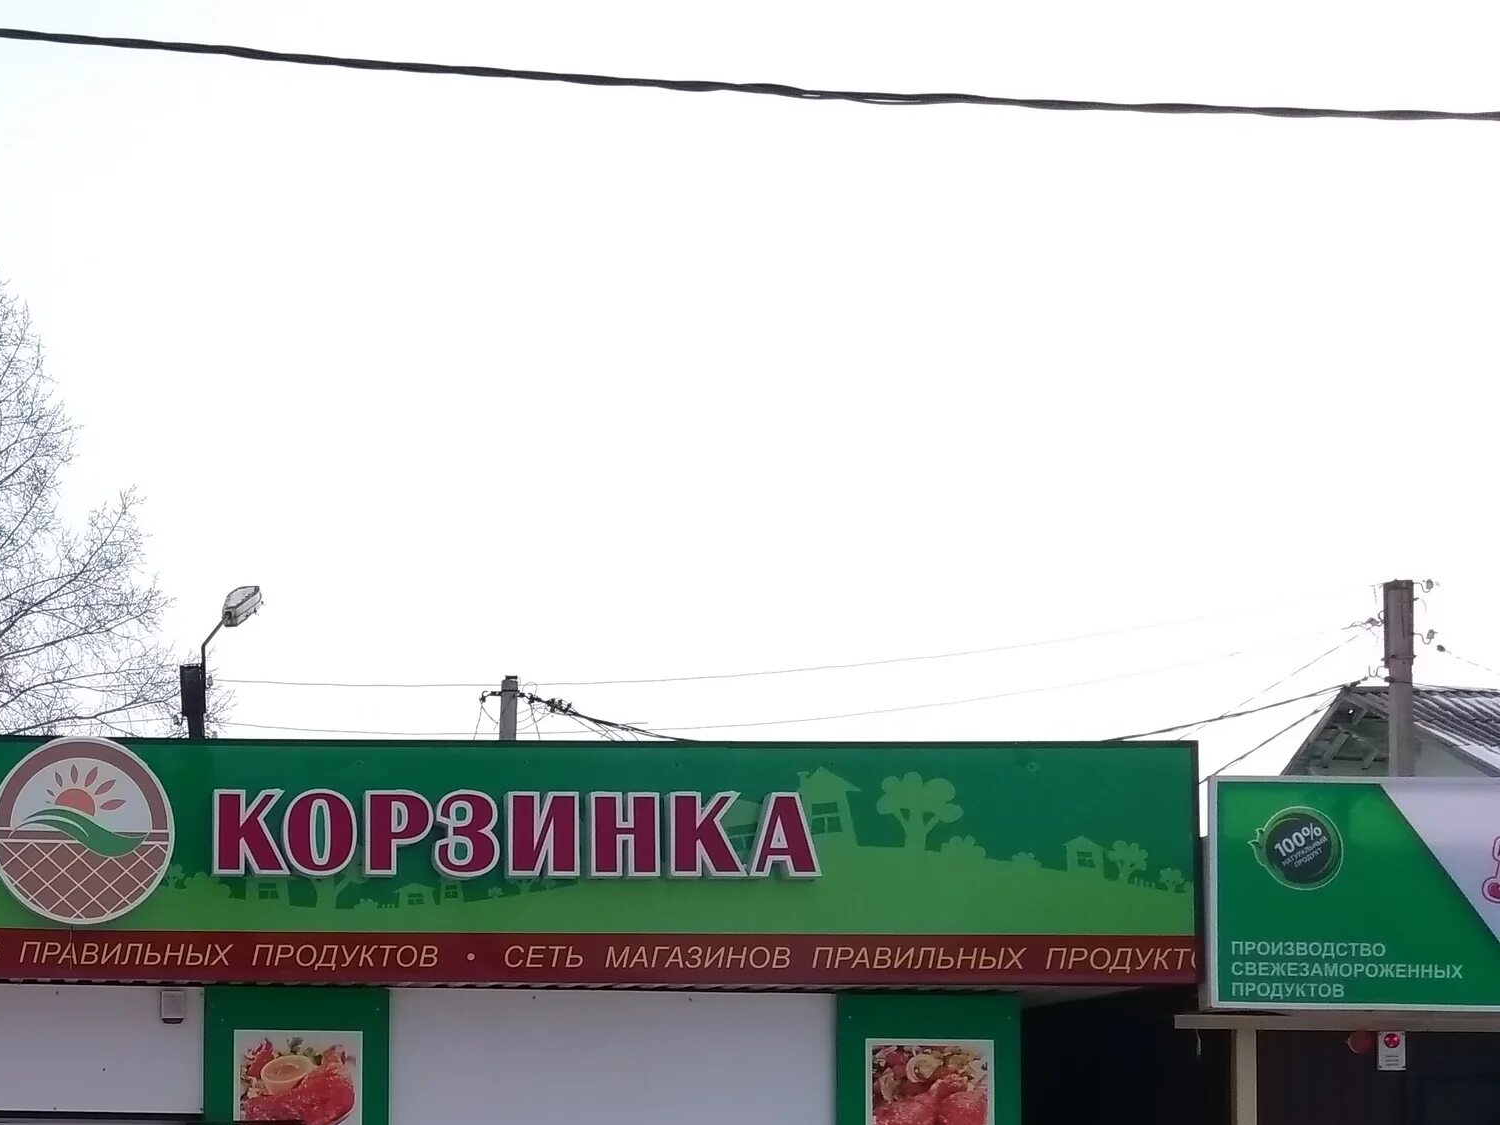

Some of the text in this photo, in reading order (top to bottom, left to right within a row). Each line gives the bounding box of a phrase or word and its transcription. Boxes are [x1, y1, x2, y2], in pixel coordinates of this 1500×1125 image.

[211, 787, 823, 880] КОРЗИНКА
[1274, 823, 1322, 857] 100%
[1281, 836, 1328, 866] НАТУРАЛЬНЫЙ
[1294, 847, 1322, 868] ПРОДУКТ
[19, 940, 234, 966] ПРАВИЛЬНЫХ
[251, 942, 439, 971] ПРОДУКТОВ
[504, 945, 585, 970] СЕТЬ
[604, 945, 791, 970] МАГАЗИНОВ
[811, 946, 1026, 971] ПРАВИЛЬНЫХ
[1044, 947, 1196, 974] ПРОДУКТ
[1231, 941, 1386, 959] ПРОИЗВОДСТВО
[1231, 962, 1463, 979] СВЕЖЕЗАМОРОЖЕННЫХ
[1231, 982, 1345, 999] ПРОДУКТОВ
